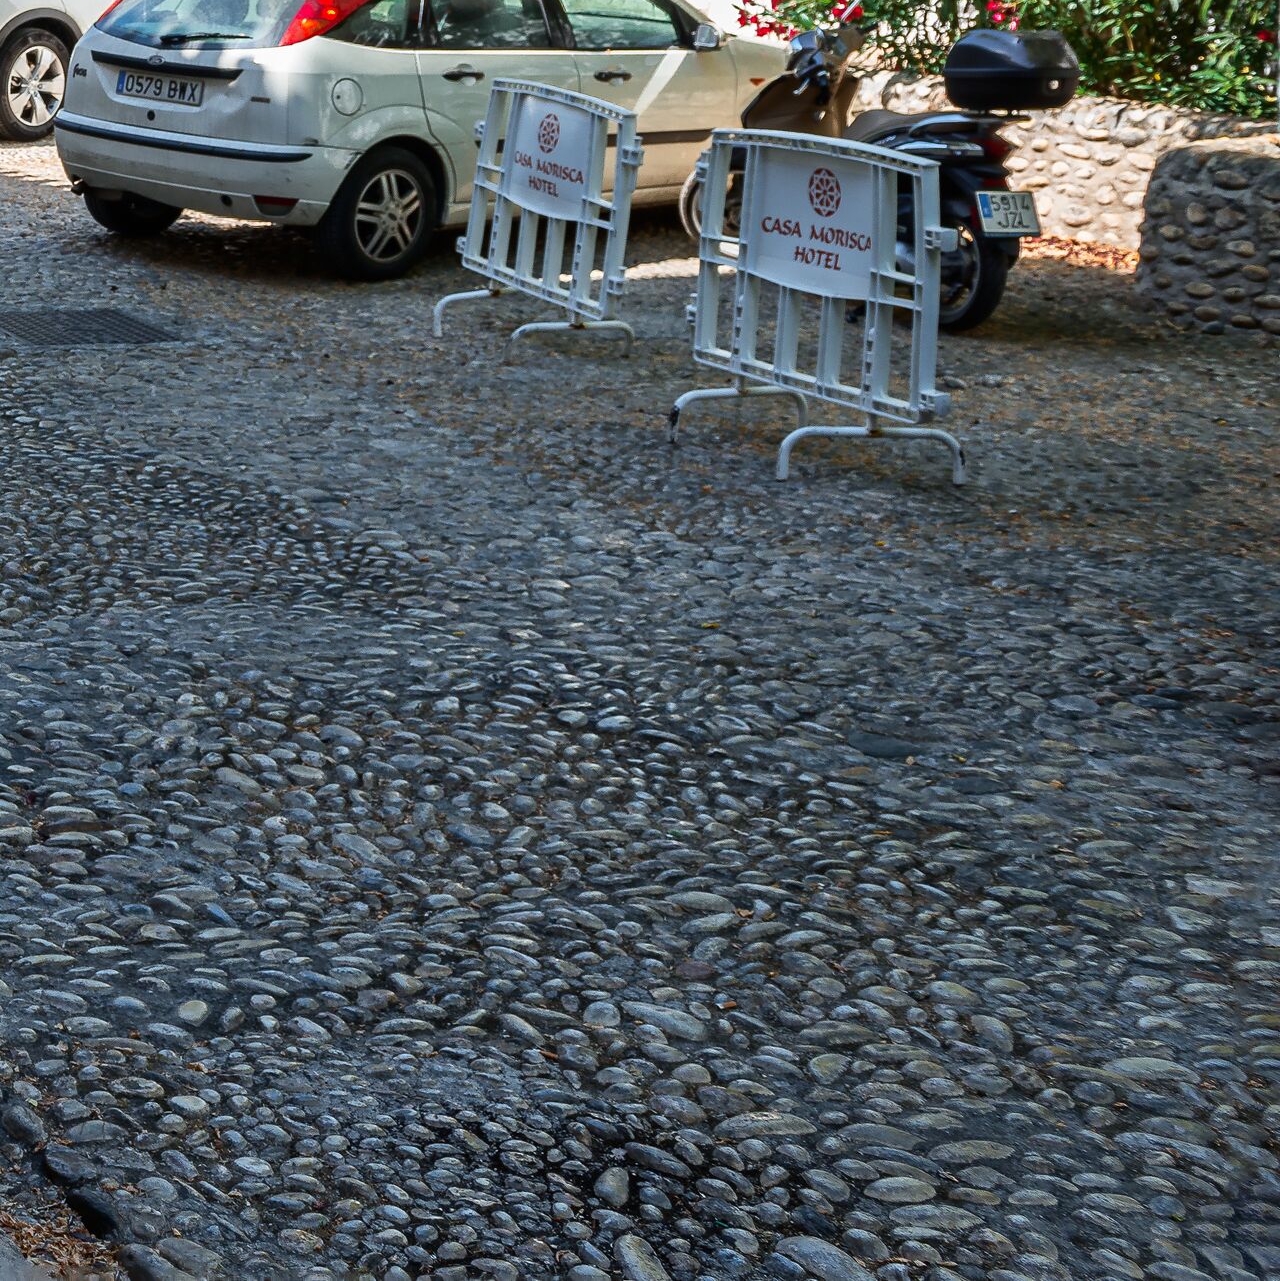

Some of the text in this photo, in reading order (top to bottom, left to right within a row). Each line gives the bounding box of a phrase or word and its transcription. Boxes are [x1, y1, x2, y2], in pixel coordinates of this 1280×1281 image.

[124, 74, 200, 102] 0579 BWX
[514, 150, 584, 185] CASA MORISCA
[528, 175, 559, 198] HOTEL
[990, 194, 1030, 211] 5914
[761, 216, 872, 253] CASA MORISCA
[794, 245, 841, 271] HOTEL
